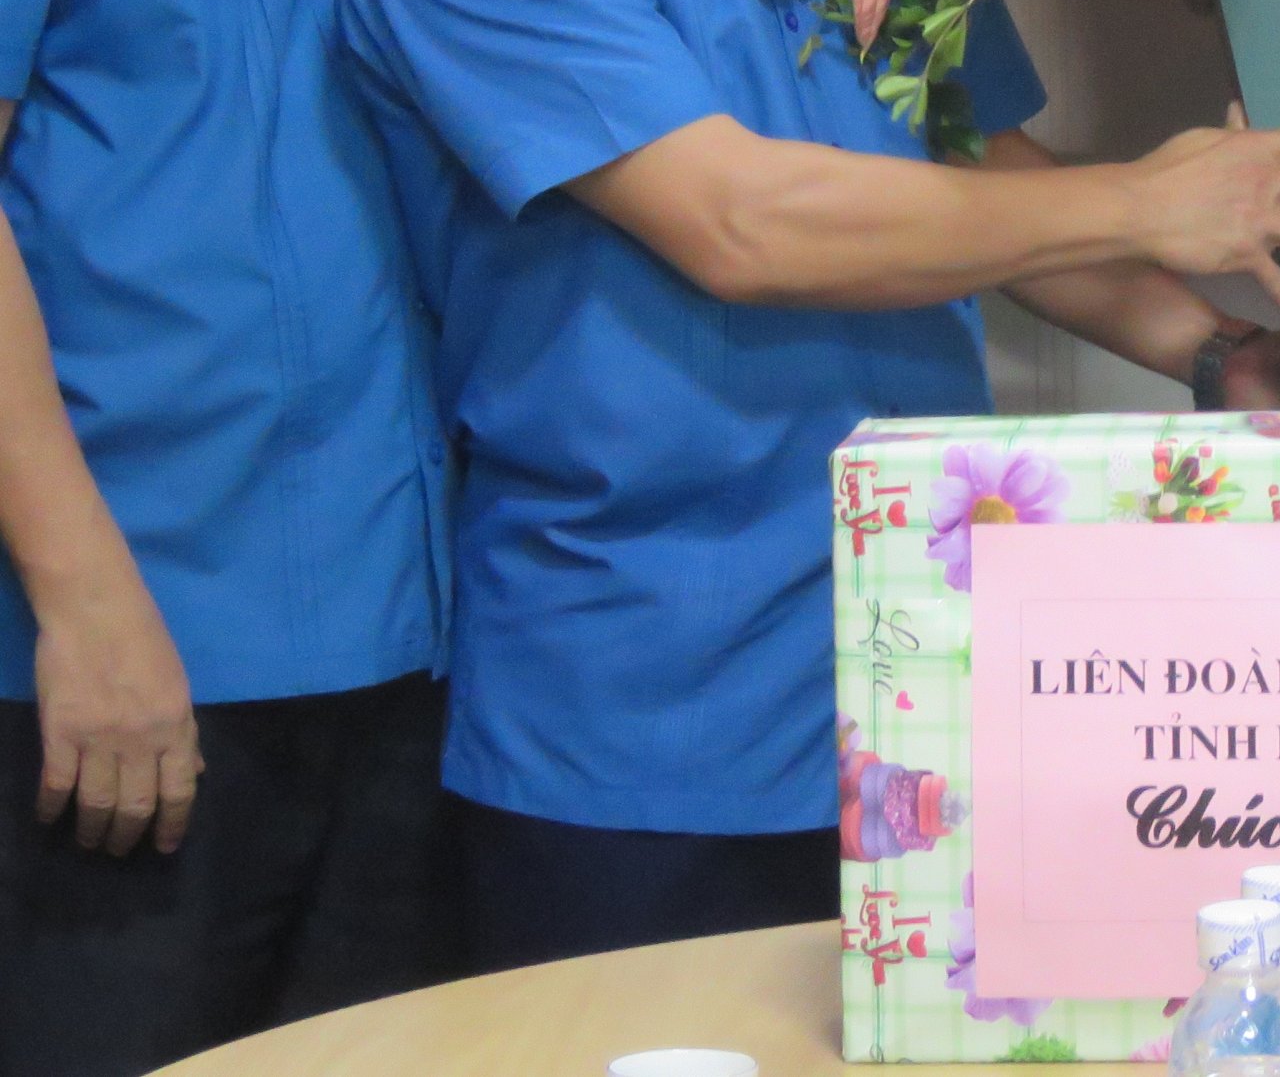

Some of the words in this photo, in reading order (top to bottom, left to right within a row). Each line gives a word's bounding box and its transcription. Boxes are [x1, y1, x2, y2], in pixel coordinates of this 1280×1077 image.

[857, 598, 921, 696] Love
[1030, 648, 1148, 695] LIÊN
[1134, 711, 1258, 760] TỈNH
